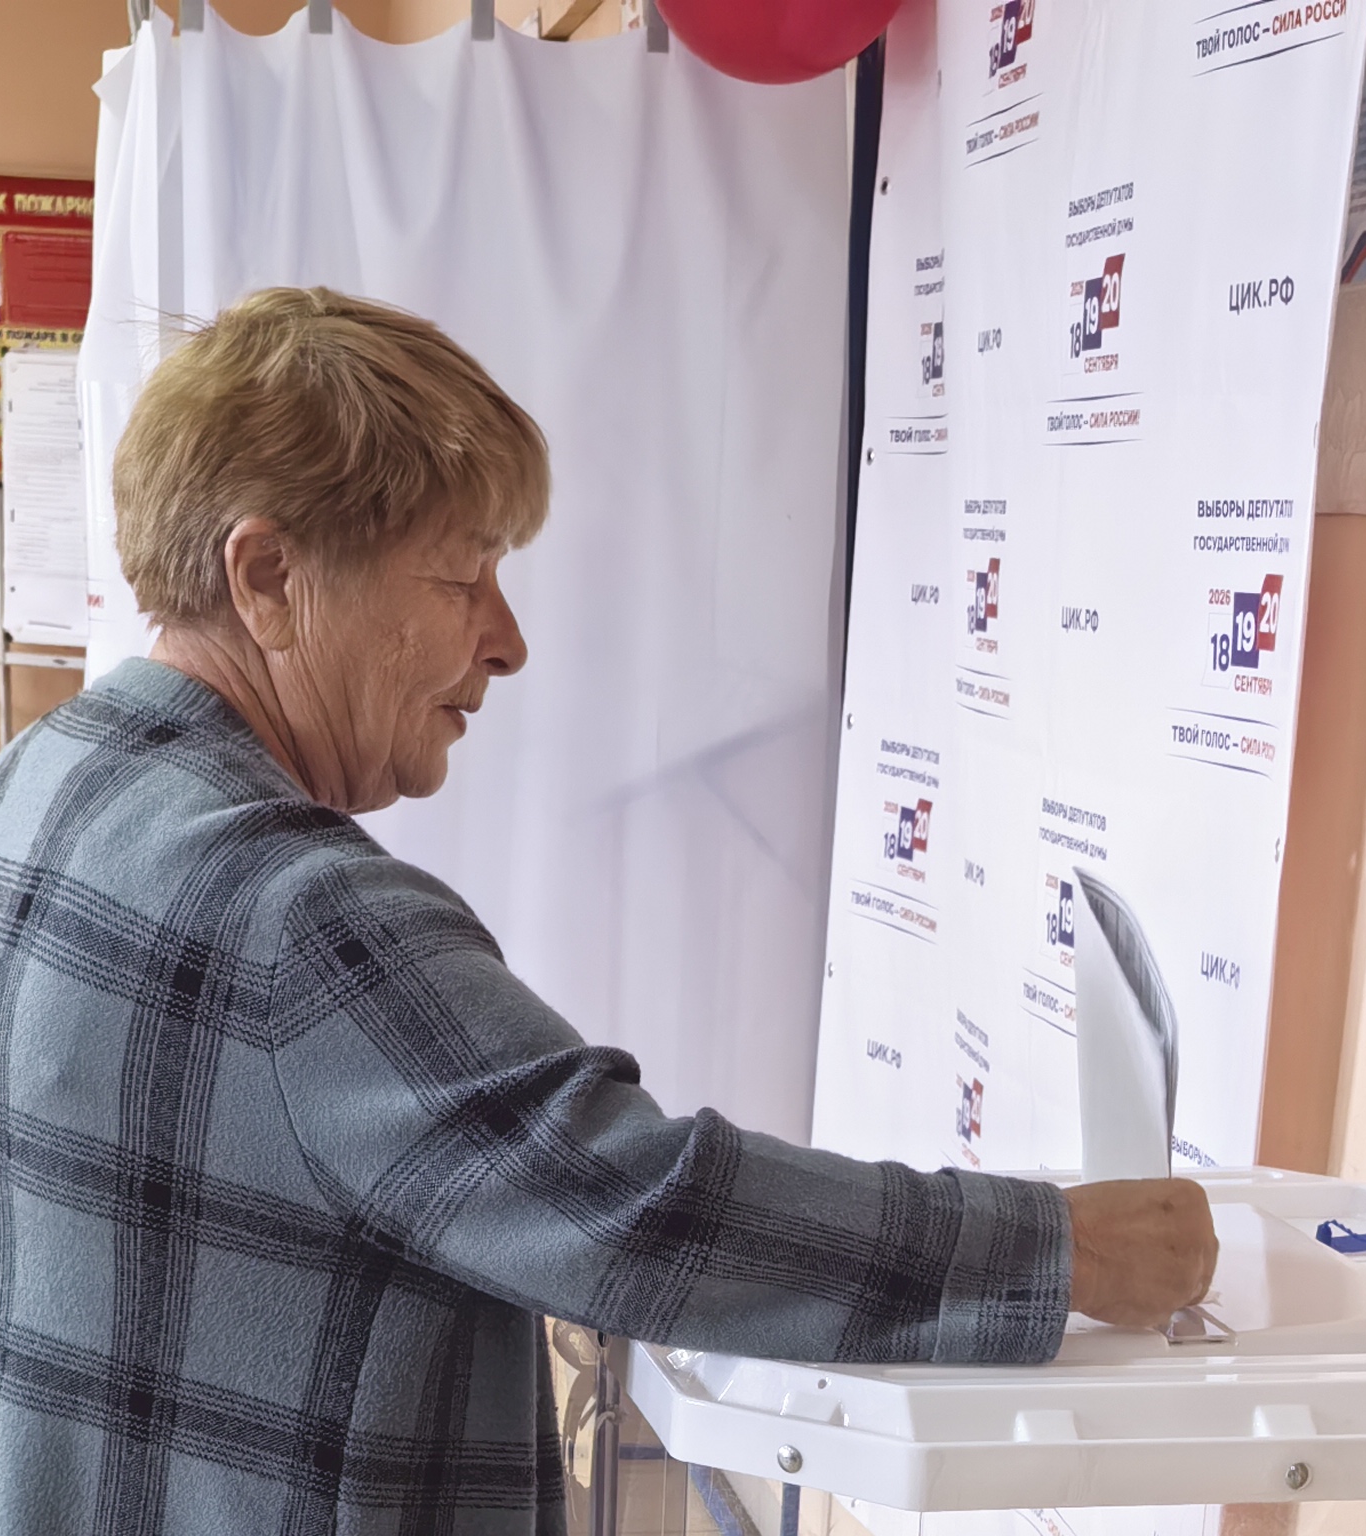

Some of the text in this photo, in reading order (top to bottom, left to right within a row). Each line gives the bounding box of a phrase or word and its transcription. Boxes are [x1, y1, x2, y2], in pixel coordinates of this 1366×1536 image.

[1003, 16, 1016, 53] 19
[1196, 29, 1220, 59] ТВОЙ
[1222, 21, 1260, 51] ГОЛОС
[1272, 8, 1302, 36] СИЛА
[1229, 275, 1295, 316] ЦИК.РФ
[1070, 272, 1119, 359] 18 19 20
[889, 427, 912, 443] ТВОЙ
[1197, 500, 1245, 518] ВЫБОРЫ
[1193, 533, 1278, 553] ГОСУДАРСТВЕННОЙ
[1208, 589, 1231, 605] 2026
[1060, 605, 1099, 632] ЦИК.РФ
[1211, 592, 1279, 672] 18 19 20
[1172, 723, 1199, 746] ТВОЙ
[1200, 730, 1231, 750] ГОЛОС
[884, 810, 929, 860] 18 19 20
[1046, 898, 1074, 946] 18 19
[867, 1038, 902, 1070] ЦИК.РФ
